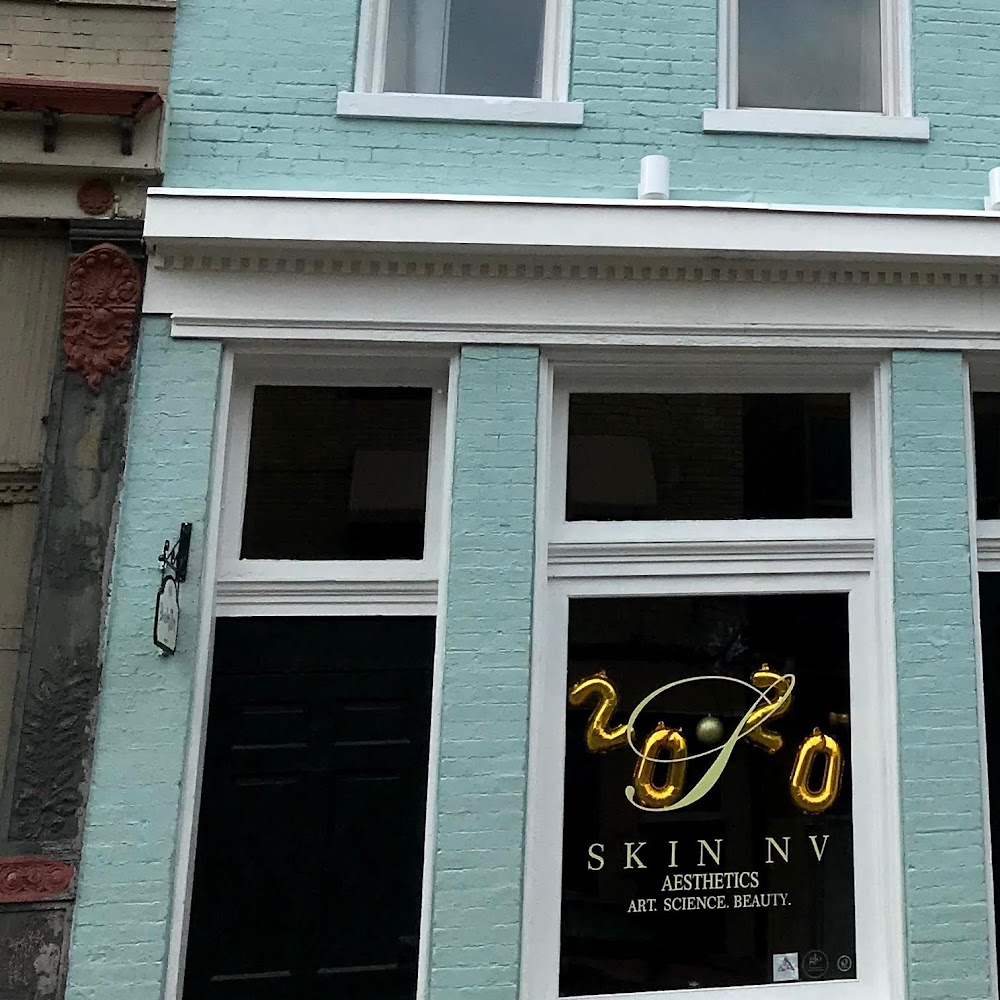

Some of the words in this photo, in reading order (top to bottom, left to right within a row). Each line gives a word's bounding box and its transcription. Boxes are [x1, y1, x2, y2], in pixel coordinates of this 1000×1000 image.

[587, 839, 723, 870] SKIN
[765, 835, 829, 863] NV
[661, 871, 759, 892] AESTHETICS
[627, 899, 657, 913] ART.
[663, 895, 729, 912] SCIENCE.
[734, 893, 792, 909] BEAUTY.
